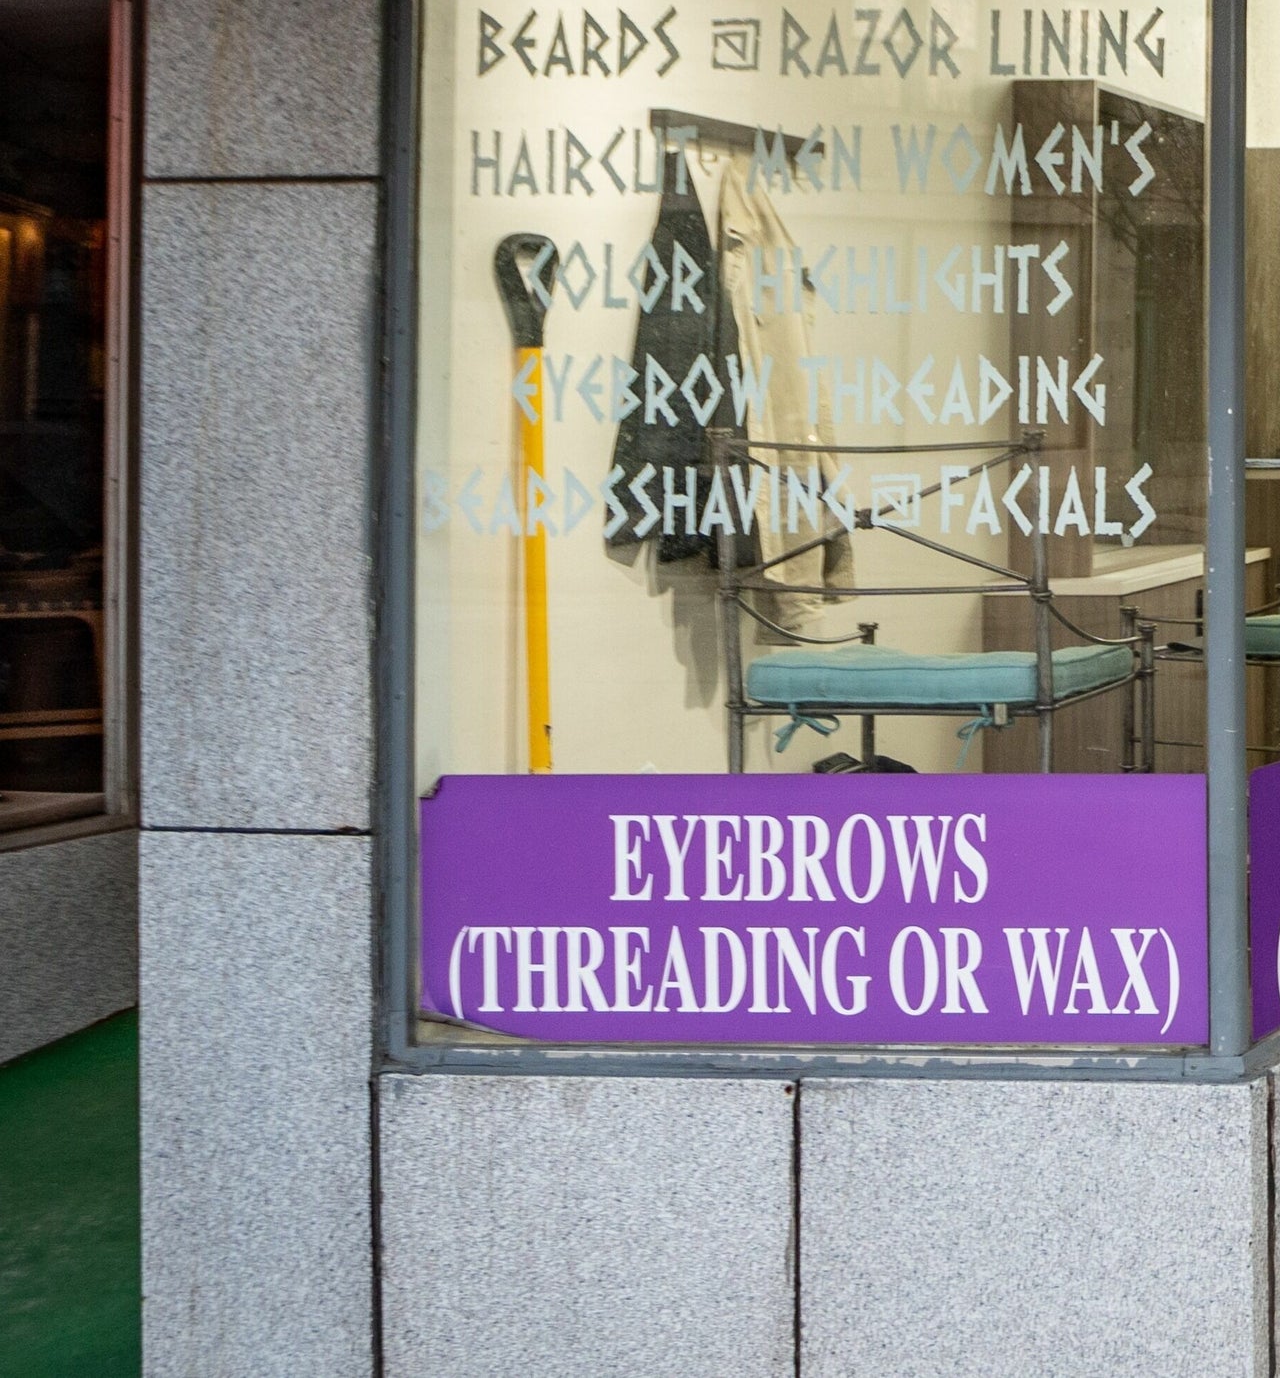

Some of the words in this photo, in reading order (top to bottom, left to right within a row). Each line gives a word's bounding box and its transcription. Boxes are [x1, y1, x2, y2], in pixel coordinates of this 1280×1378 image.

[477, 6, 681, 78] BEARDS
[780, 7, 961, 78] RAZOR
[990, 7, 1167, 78] LINING
[469, 124, 700, 198] HAIRCUT
[745, 122, 864, 197] MEN
[891, 120, 1154, 198] WOMEN'S
[526, 239, 706, 316] COLOR
[752, 239, 1075, 316] HIGHLIGHTS
[511, 352, 774, 427] EYEBROW
[800, 352, 1107, 428] THREADING
[421, 462, 856, 541] BEARDSSHAVING
[938, 462, 1157, 540] FACIALS
[608, 812, 989, 905] EYEBROWS
[449, 925, 873, 1020] (THREADING
[888, 925, 990, 1016] OR
[1003, 924, 1182, 1035] WAX)
